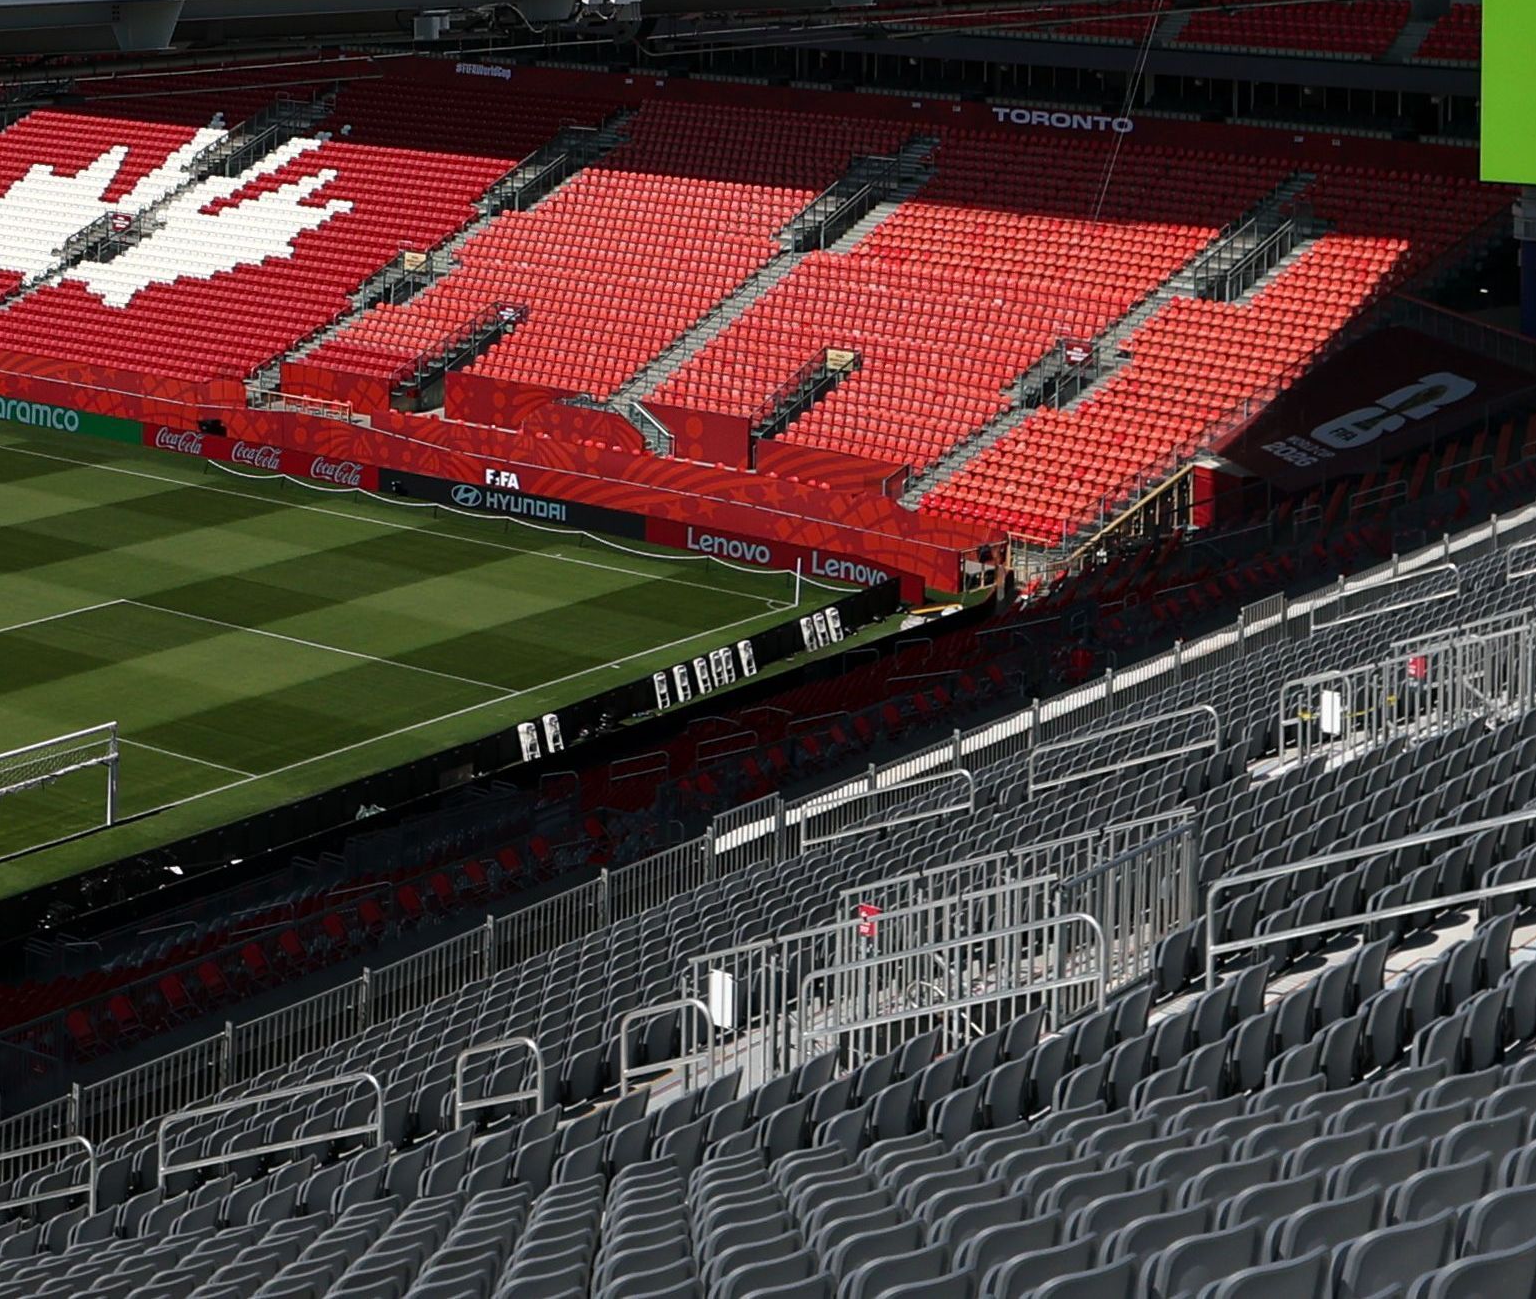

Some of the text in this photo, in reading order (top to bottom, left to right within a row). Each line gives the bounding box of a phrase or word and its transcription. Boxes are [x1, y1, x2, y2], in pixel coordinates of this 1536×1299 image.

[991, 107, 1134, 133] TORONTO
[1330, 426, 1358, 443] FIFA
[486, 491, 566, 521] HYUNDAI
[687, 526, 770, 564] Lenovo
